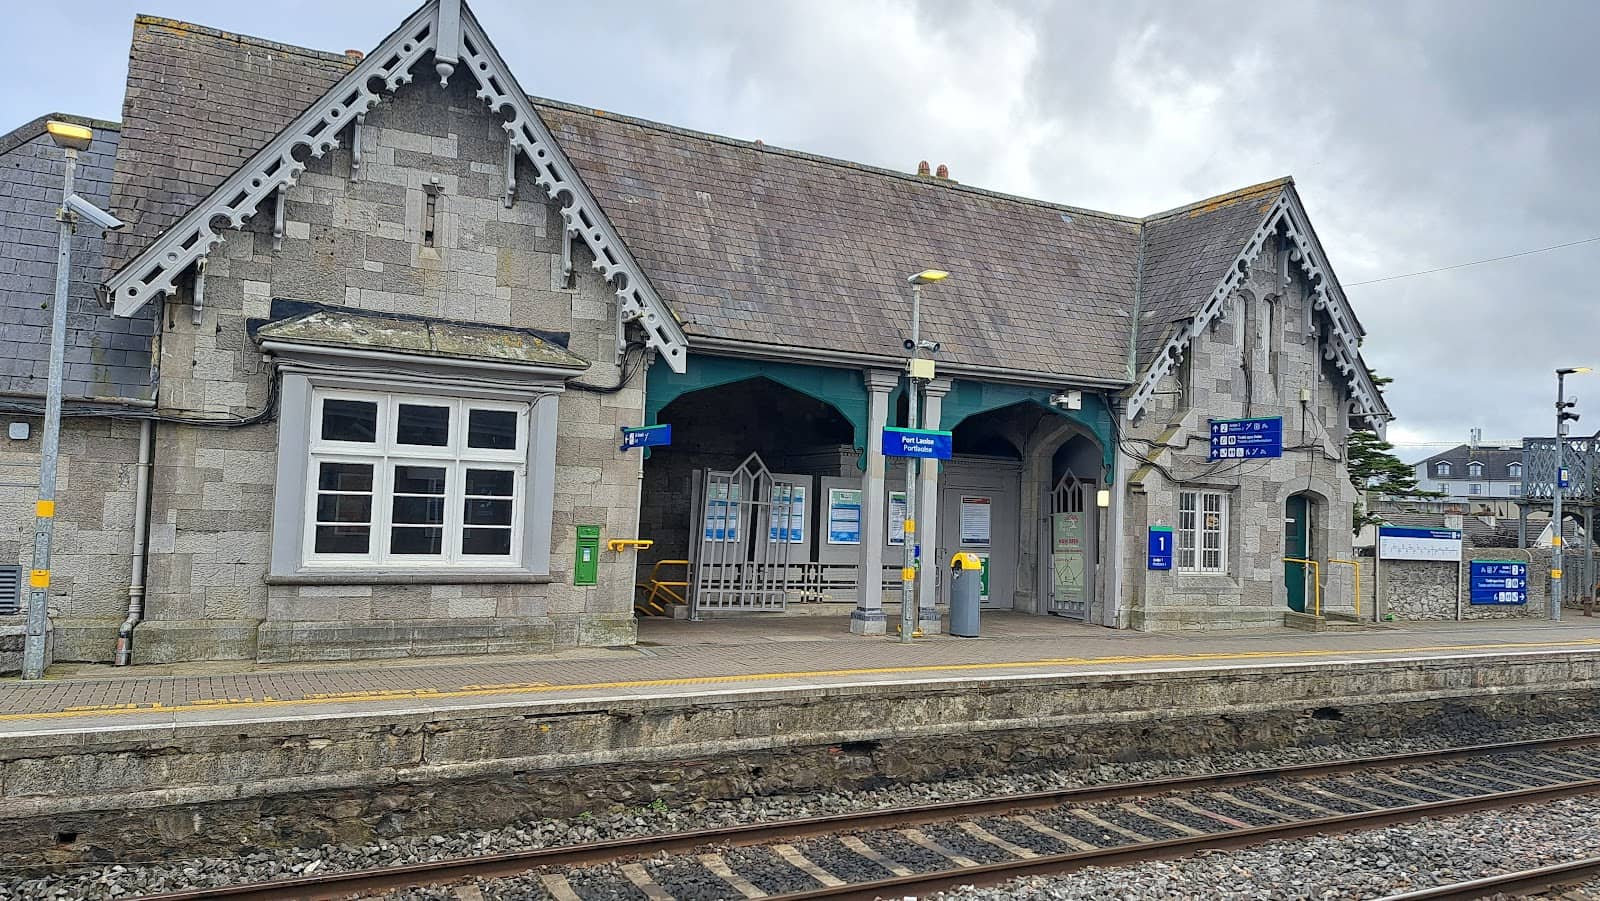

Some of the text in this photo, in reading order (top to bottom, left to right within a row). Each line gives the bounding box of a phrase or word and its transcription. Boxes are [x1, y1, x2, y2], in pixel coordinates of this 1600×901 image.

[902, 436, 934, 445] Port Laoise
[904, 444, 932, 453] Portlaoise
[1159, 536, 1165, 551] 1
